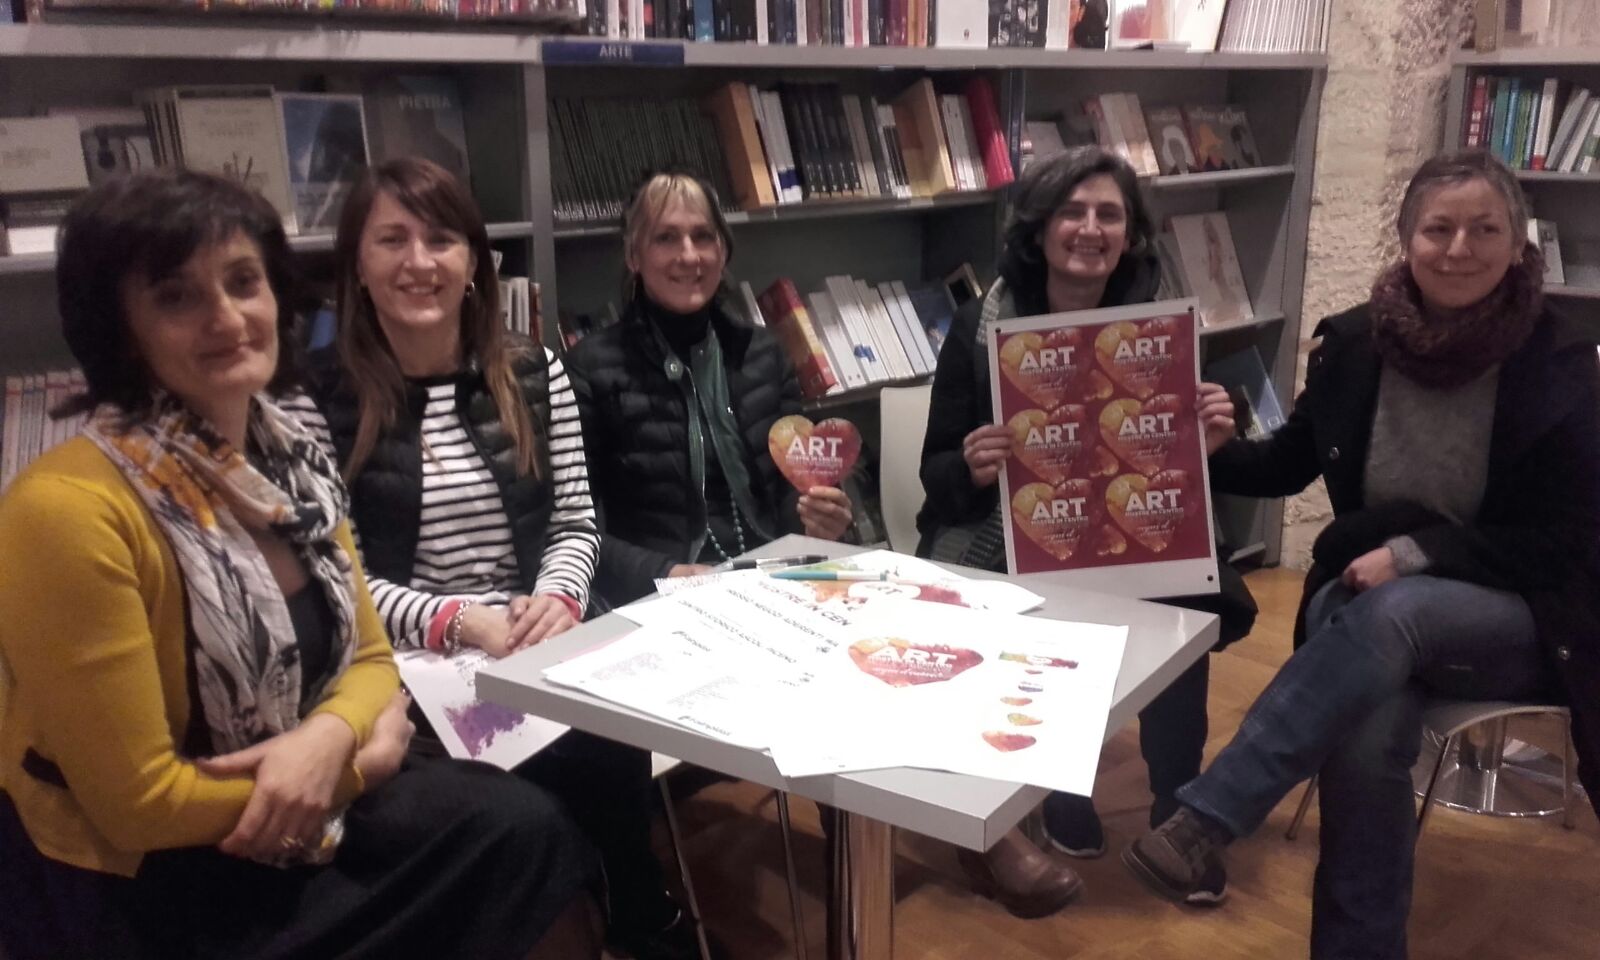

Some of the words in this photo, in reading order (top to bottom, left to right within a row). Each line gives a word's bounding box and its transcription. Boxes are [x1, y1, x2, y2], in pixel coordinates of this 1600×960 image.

[600, 45, 632, 58] ARTE
[1019, 346, 1076, 370] ART
[1114, 335, 1172, 360] ART
[1025, 422, 1080, 446] ART
[1119, 412, 1175, 436] ART
[787, 434, 843, 457] ART
[1031, 497, 1087, 521] ART
[1126, 488, 1182, 512] ART
[871, 646, 958, 665] ART
